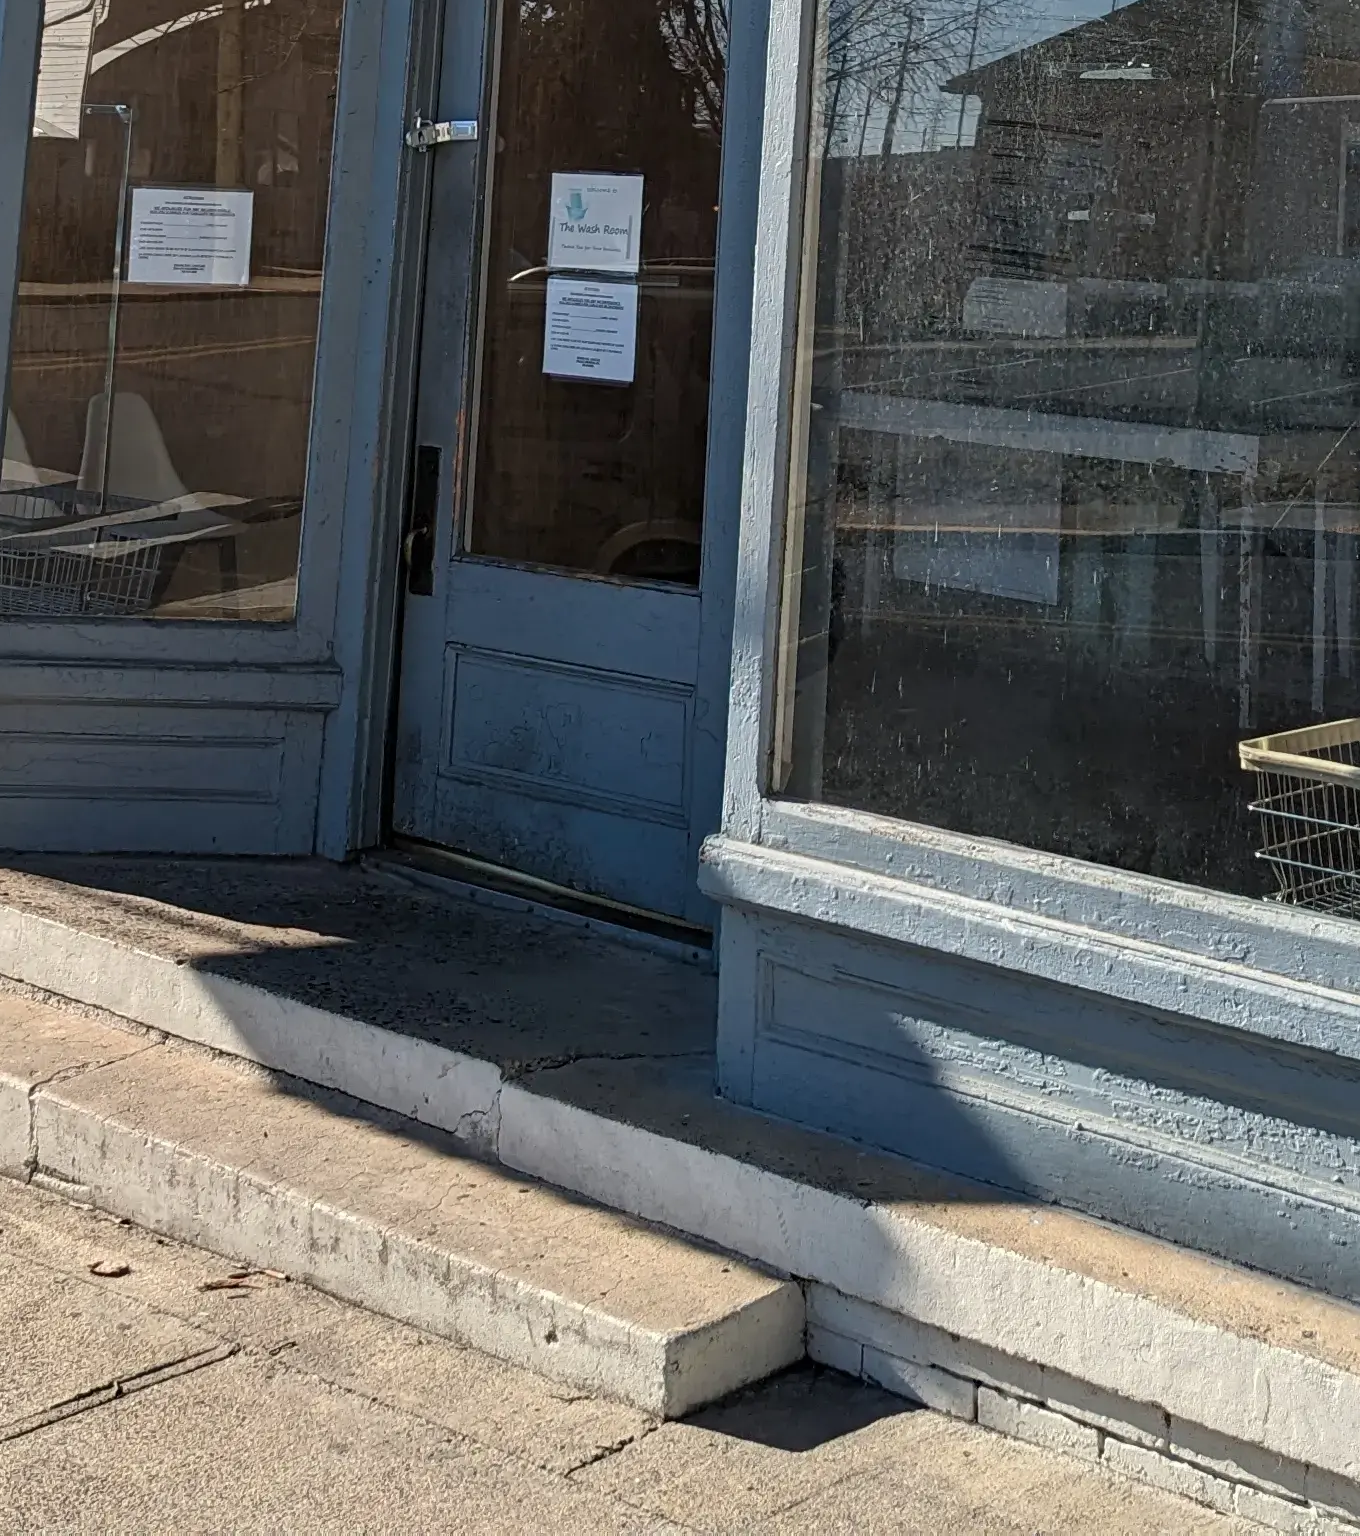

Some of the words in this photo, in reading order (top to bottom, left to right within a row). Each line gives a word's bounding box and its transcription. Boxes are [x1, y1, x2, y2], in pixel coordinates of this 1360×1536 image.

[560, 222, 575, 232] The
[577, 224, 600, 234] Wash
[603, 225, 629, 236] Room
